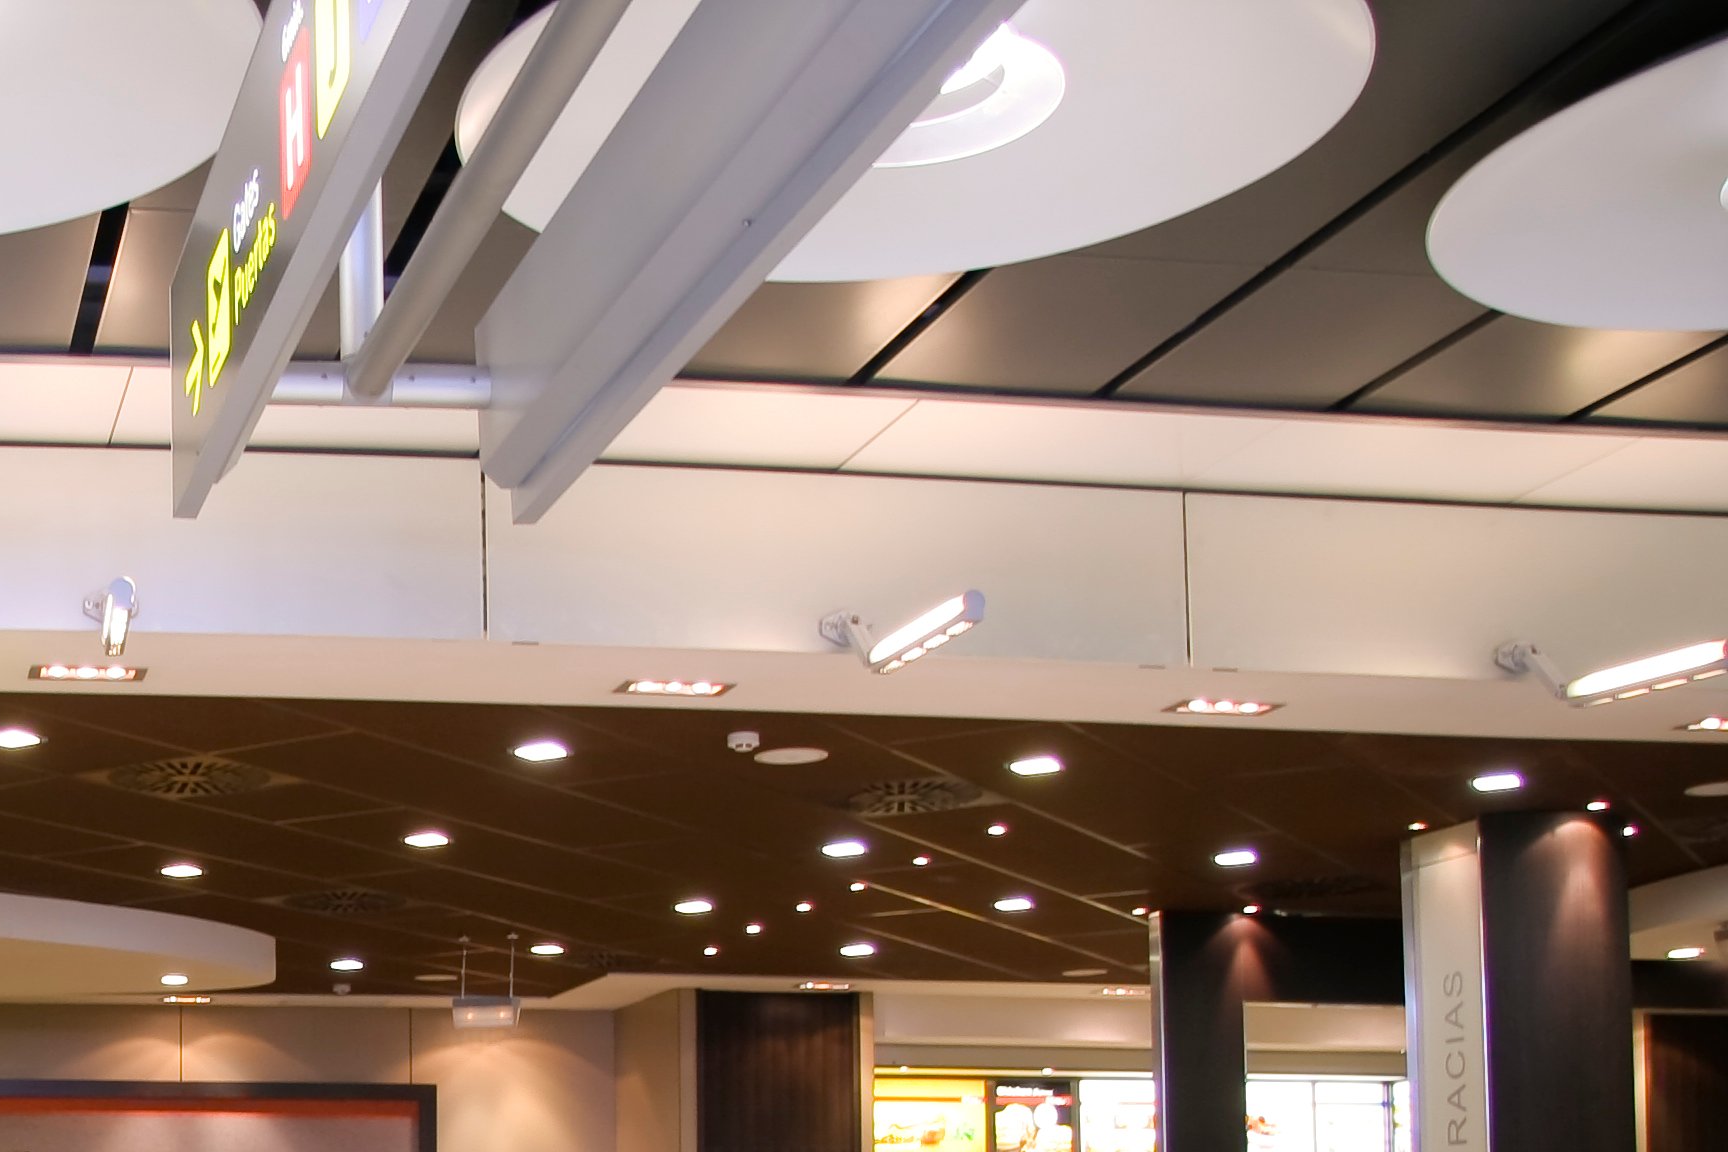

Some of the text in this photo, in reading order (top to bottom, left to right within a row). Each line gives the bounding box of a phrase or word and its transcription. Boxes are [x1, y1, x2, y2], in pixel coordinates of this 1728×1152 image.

[285, 62, 304, 192] H
[233, 168, 259, 253] Gates
[234, 202, 276, 325] Puertas
